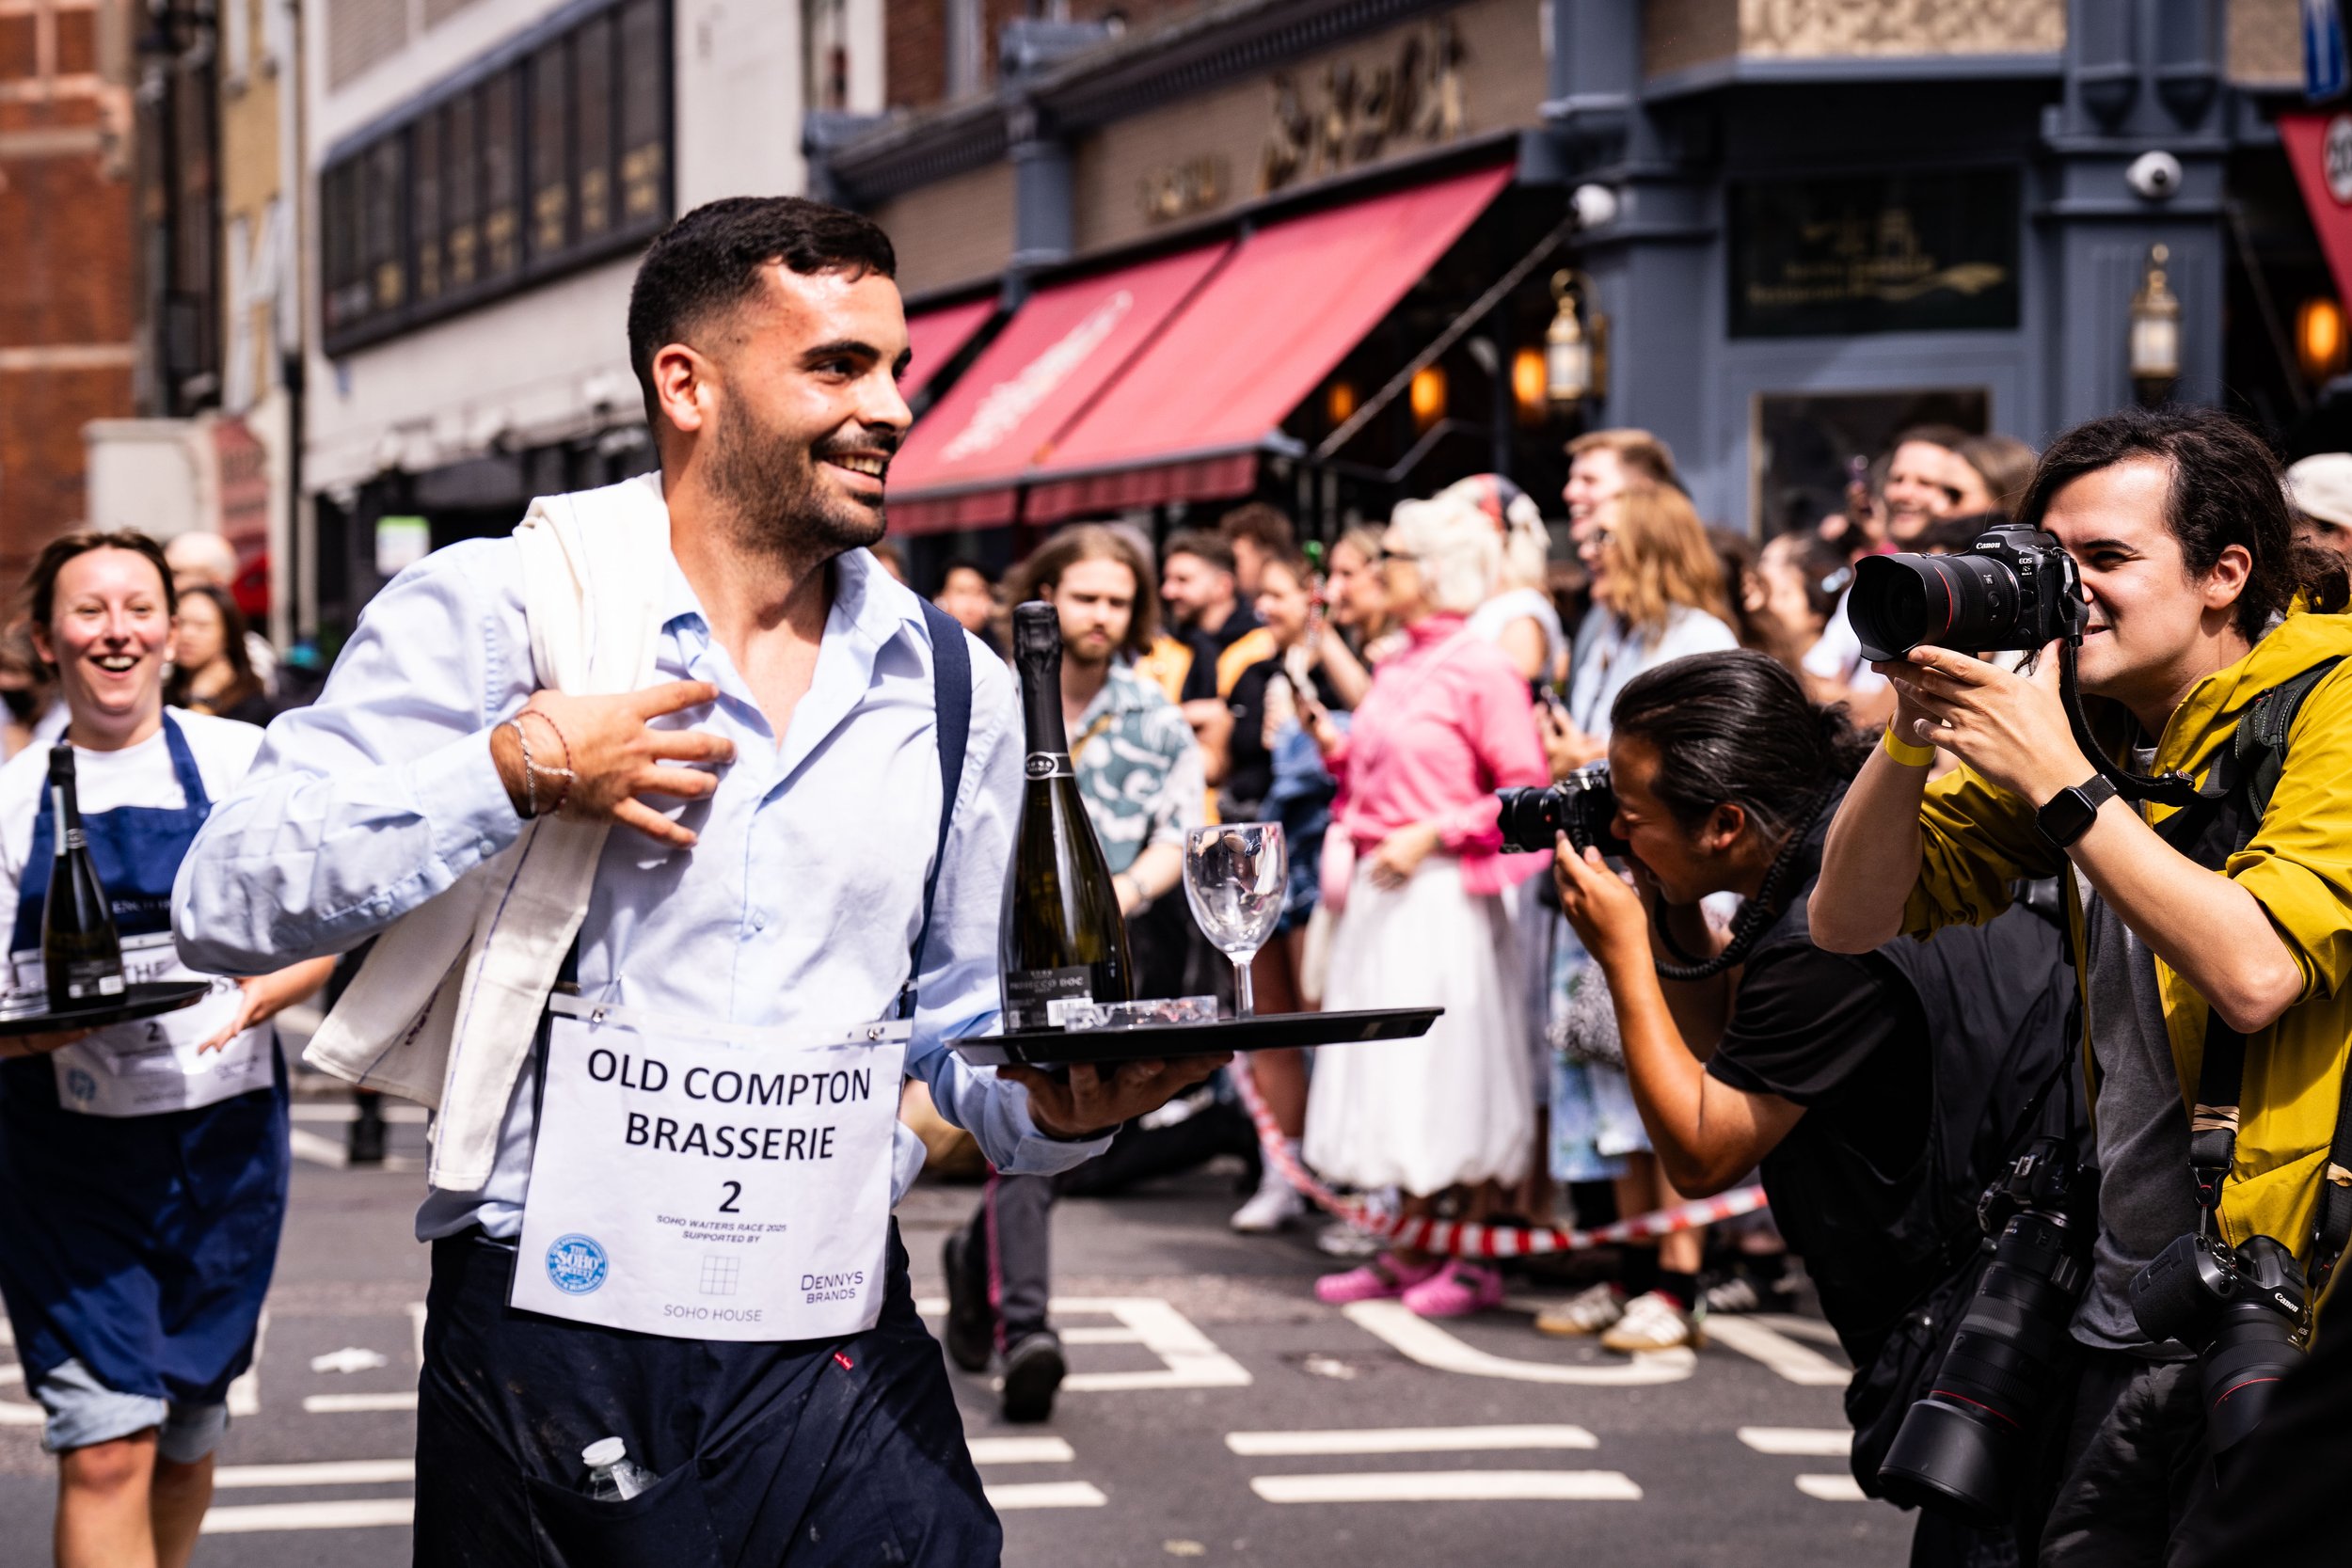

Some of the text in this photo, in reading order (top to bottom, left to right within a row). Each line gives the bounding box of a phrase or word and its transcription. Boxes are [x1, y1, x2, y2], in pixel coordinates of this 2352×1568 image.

[1060, 977, 1083, 988] DOC
[146, 1022, 159, 1041] 2
[588, 1048, 872, 1106] OLD COMPTON
[625, 1111, 836, 1161] BRASSERIE
[719, 1180, 742, 1213] 2
[657, 1215, 686, 1227] SOHO
[689, 1220, 735, 1231] WAITERS
[737, 1223, 764, 1232] RACE
[682, 1231, 761, 1243] SUPPORTED BY
[554, 1250, 598, 1272] SOHO
[801, 1271, 864, 1291] DENNYS
[806, 1288, 856, 1304] BRANDS
[2275, 1292, 2298, 1312] Canon
[663, 1304, 762, 1322] SOHO HOUSE
[2297, 1327, 2309, 1336] EOS
